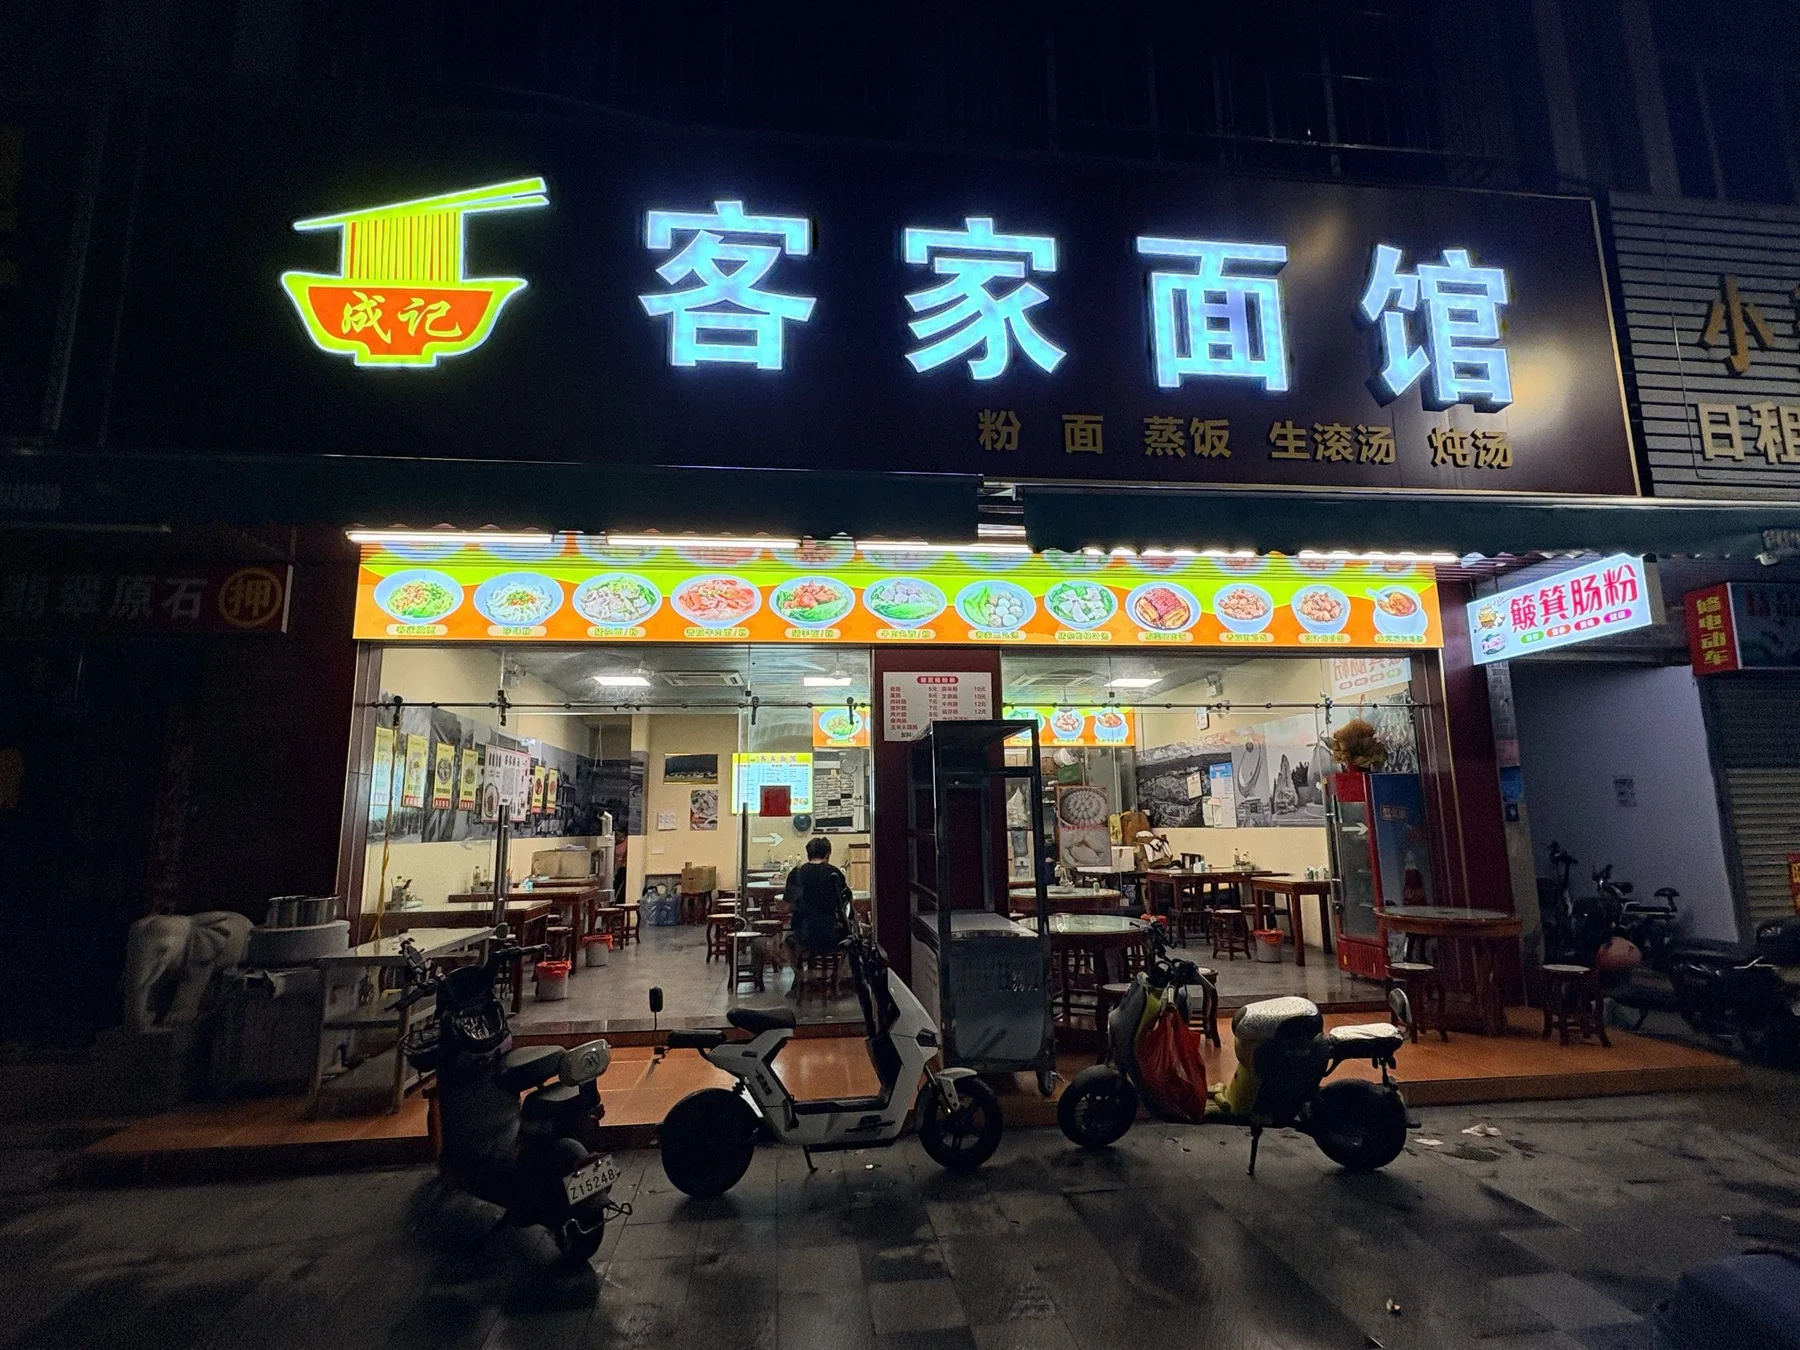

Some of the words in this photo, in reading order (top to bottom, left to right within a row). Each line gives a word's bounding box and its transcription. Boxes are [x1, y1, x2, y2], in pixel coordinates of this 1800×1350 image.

[341, 290, 462, 344] 成记
[637, 200, 1514, 404] 客家面馆
[978, 409, 1022, 452] 粉
[1061, 414, 1105, 454] 面
[1143, 416, 1232, 459] 蒸饭
[1268, 420, 1396, 466] 生滚汤
[1429, 426, 1513, 470] 炖汤
[227, 577, 272, 619] 押
[570, 1168, 615, 1201] Z15248
